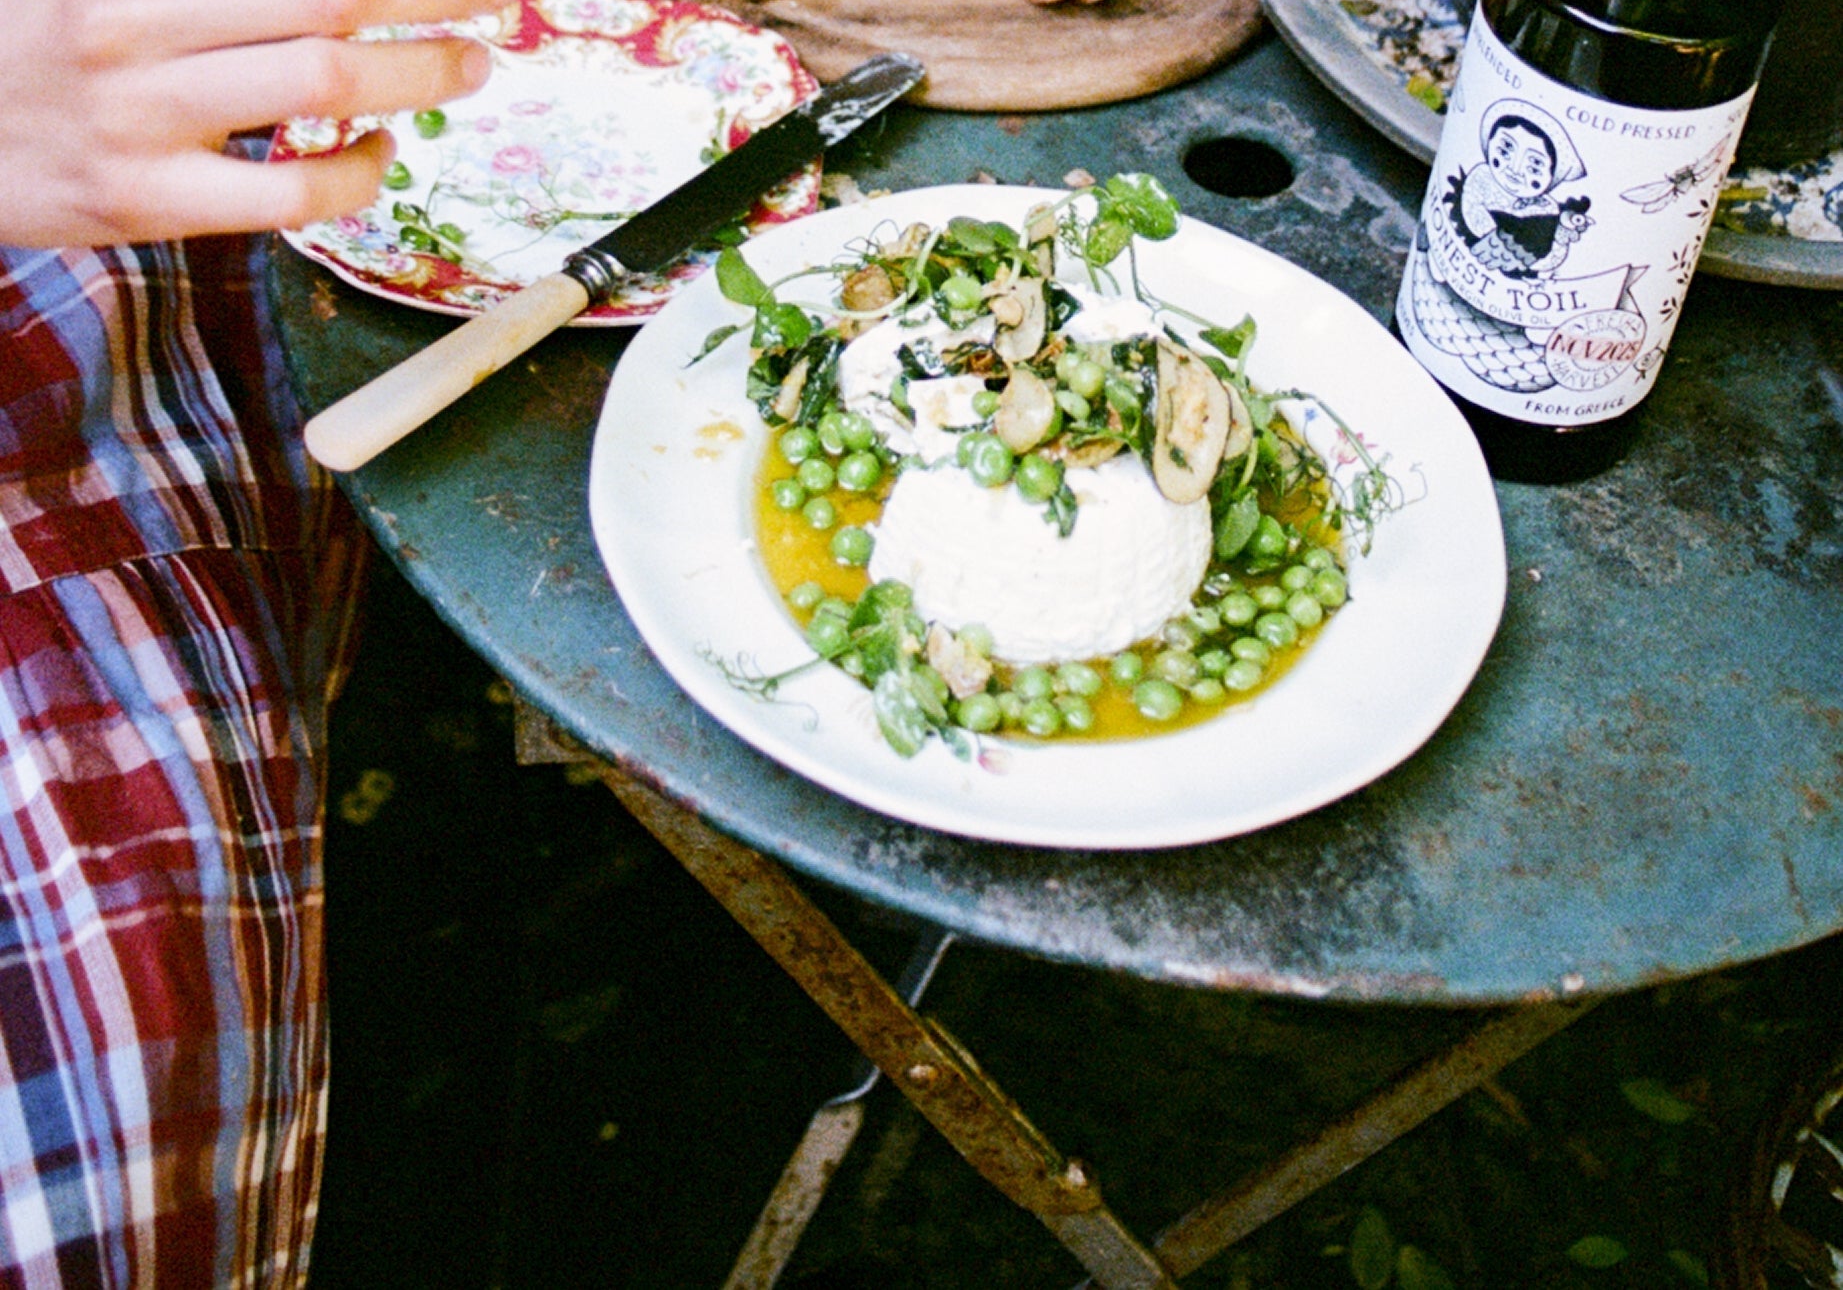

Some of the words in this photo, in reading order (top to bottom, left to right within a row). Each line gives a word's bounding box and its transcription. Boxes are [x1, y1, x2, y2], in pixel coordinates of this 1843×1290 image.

[1565, 105, 1616, 133] COLD
[1620, 121, 1697, 141] PRESSED
[1429, 184, 1497, 296] HONEST
[1506, 288, 1588, 312] TOIL
[1450, 275, 1485, 310] VIRGIN
[1488, 303, 1523, 324] OLIVE
[1529, 314, 1552, 326] OIL
[1551, 359, 1622, 390] HARVEST
[1524, 400, 1570, 416] FROM
[1573, 394, 1627, 417] GREECE
